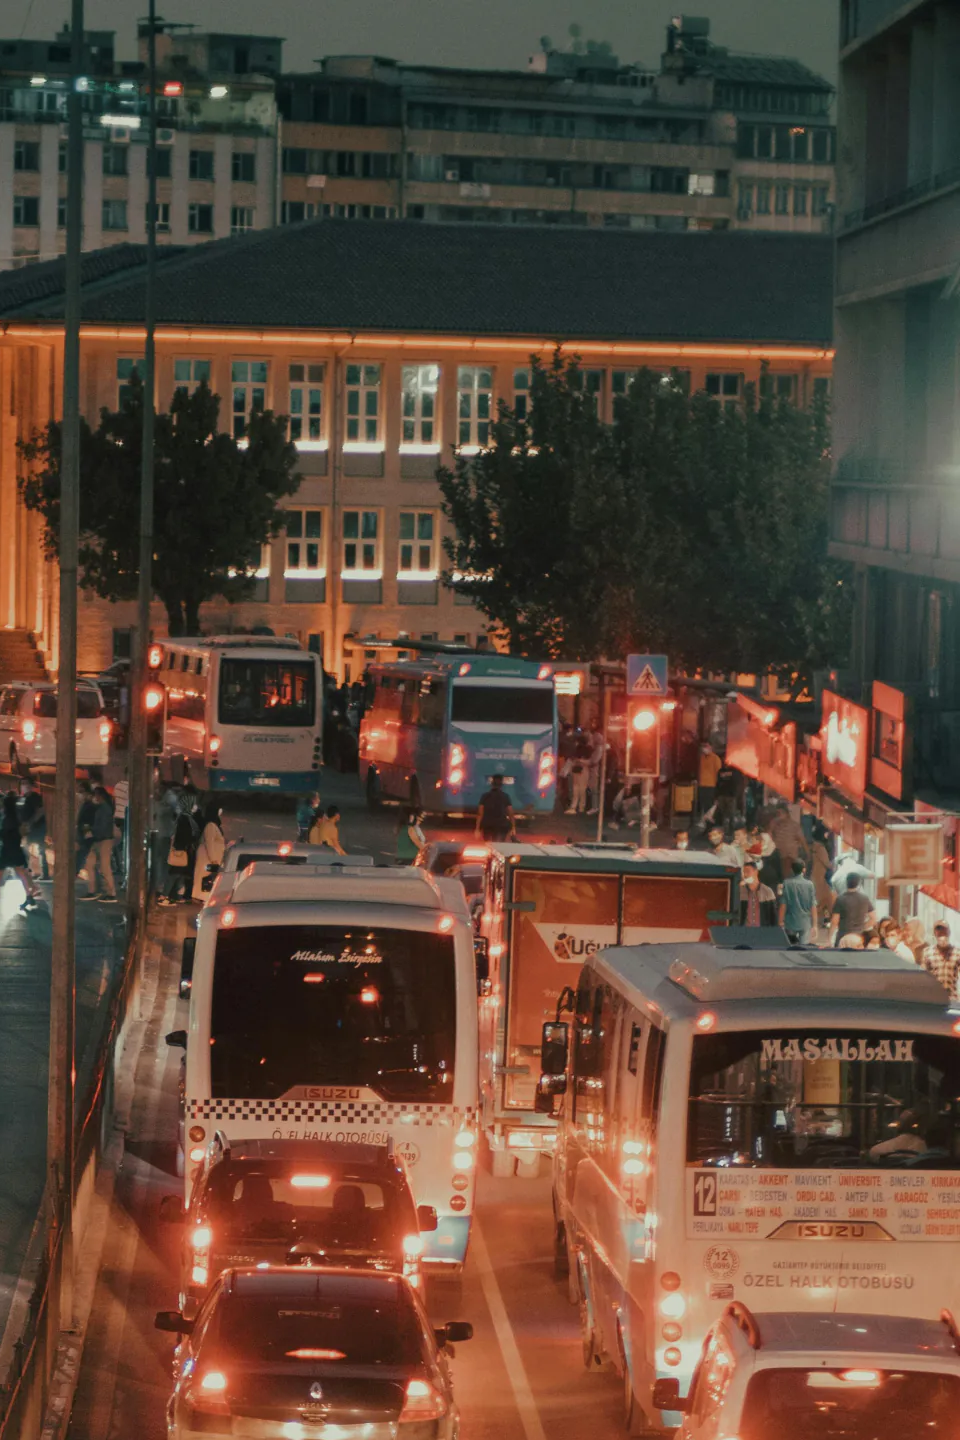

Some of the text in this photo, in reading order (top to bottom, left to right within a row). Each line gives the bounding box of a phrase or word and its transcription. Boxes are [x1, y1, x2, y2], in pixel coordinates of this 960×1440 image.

[760, 1038, 914, 1064] MAŞALLAH
[304, 1088, 360, 1099] ISUZU
[695, 1176, 716, 1213] 12
[798, 1225, 864, 1237] ISUZU
[715, 1251, 728, 1261] 12
[743, 1272, 914, 1289] ÖZEL HALK OTOBÜSÜ
